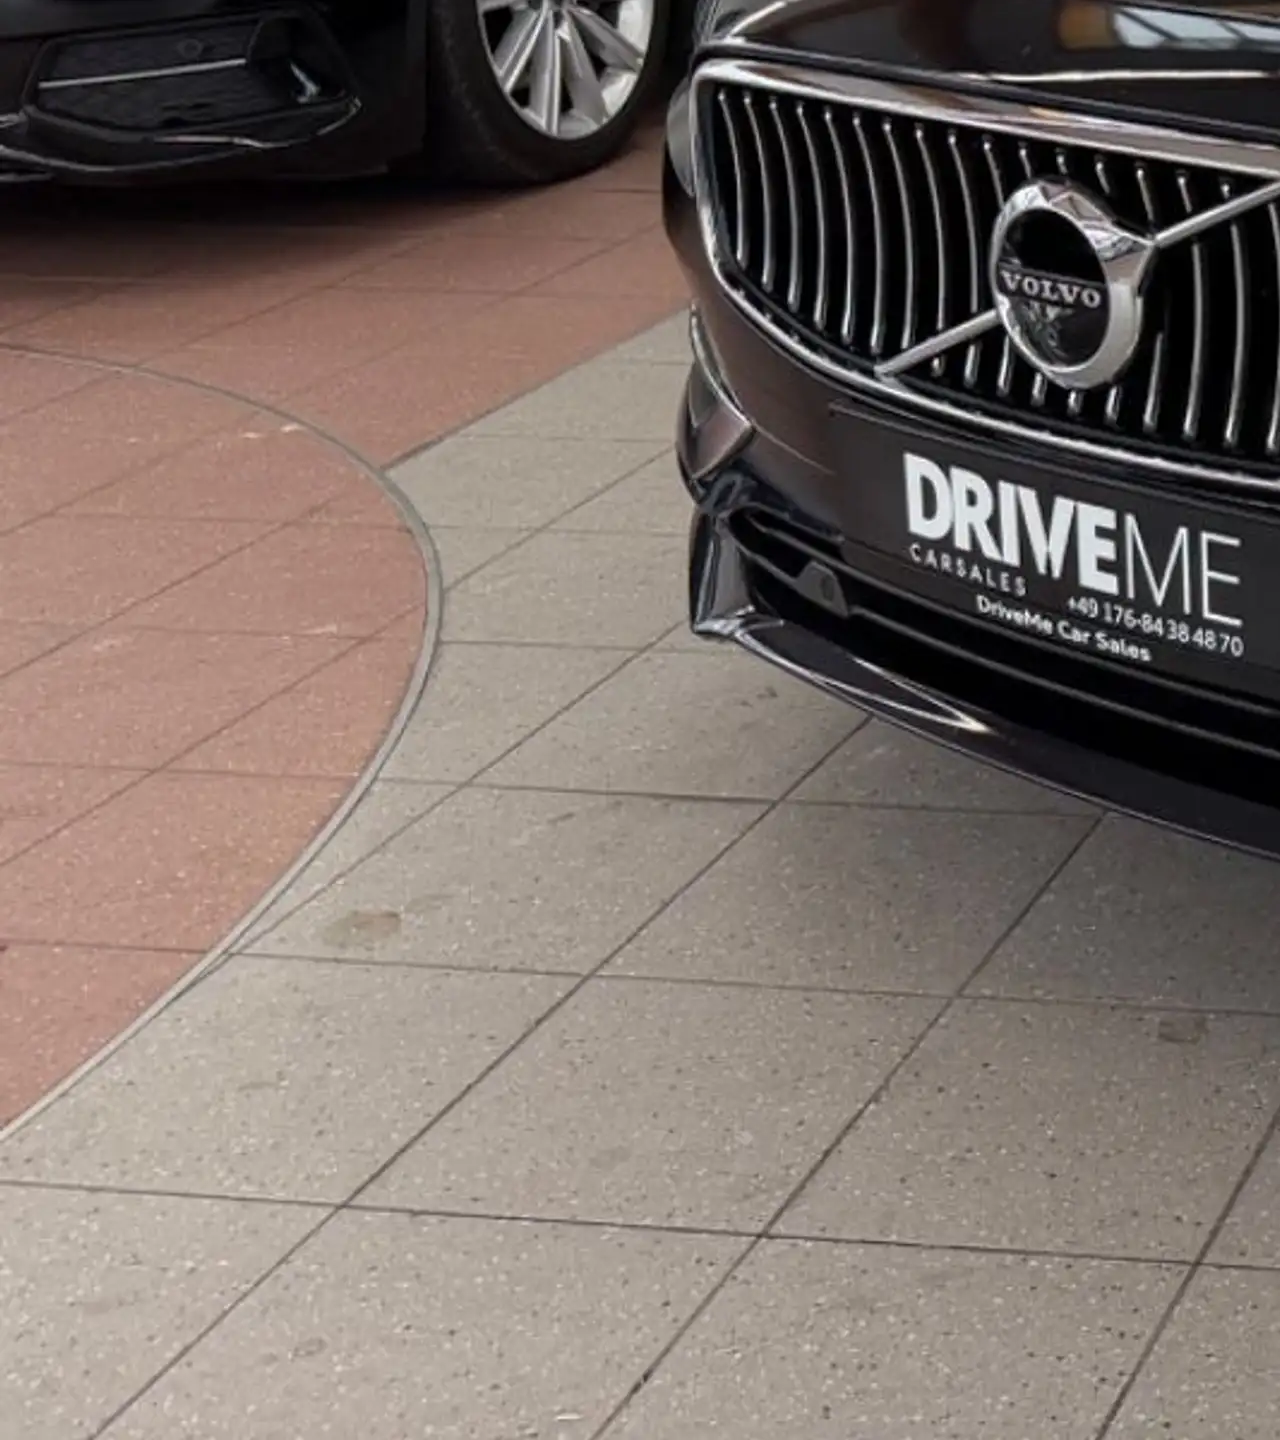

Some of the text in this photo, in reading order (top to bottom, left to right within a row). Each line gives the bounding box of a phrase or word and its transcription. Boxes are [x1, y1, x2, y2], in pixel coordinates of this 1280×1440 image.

[1000, 271, 1102, 309] VOLVO
[909, 542, 1027, 597] CARSALES
[976, 594, 1151, 662] DriveMe Car Sales
[1067, 595, 1099, 618] +49
